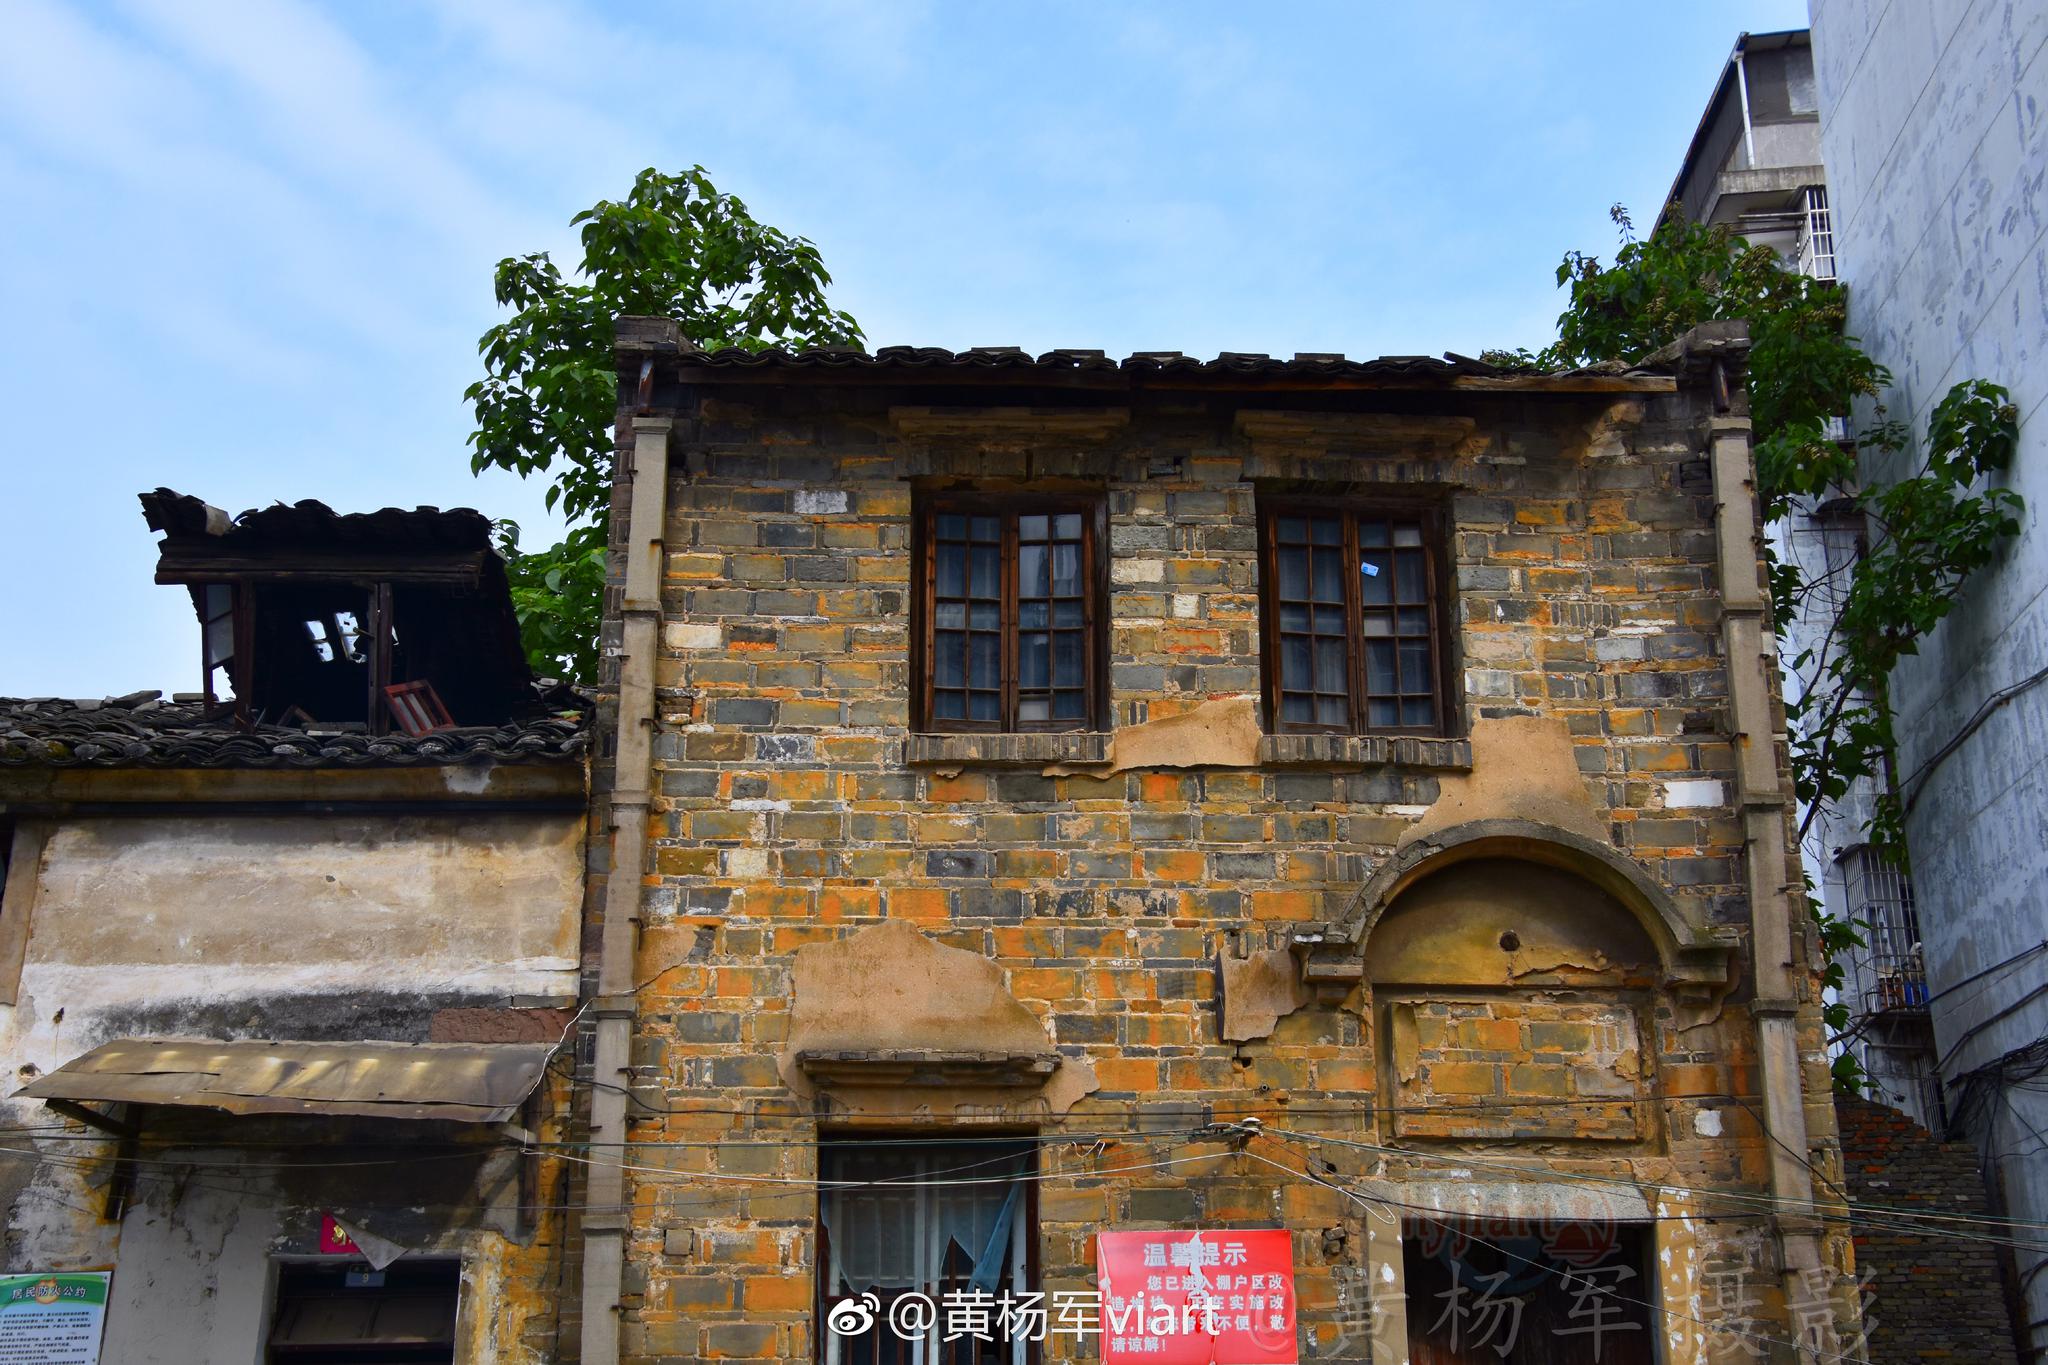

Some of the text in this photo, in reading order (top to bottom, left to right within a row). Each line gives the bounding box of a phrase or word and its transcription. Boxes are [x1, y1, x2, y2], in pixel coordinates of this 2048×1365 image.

[1143, 1242, 1247, 1267] 温馨提示
[1146, 1275, 1284, 1291] 您已进入棚户区改
[12, 1286, 86, 1299] 居民防火公约
